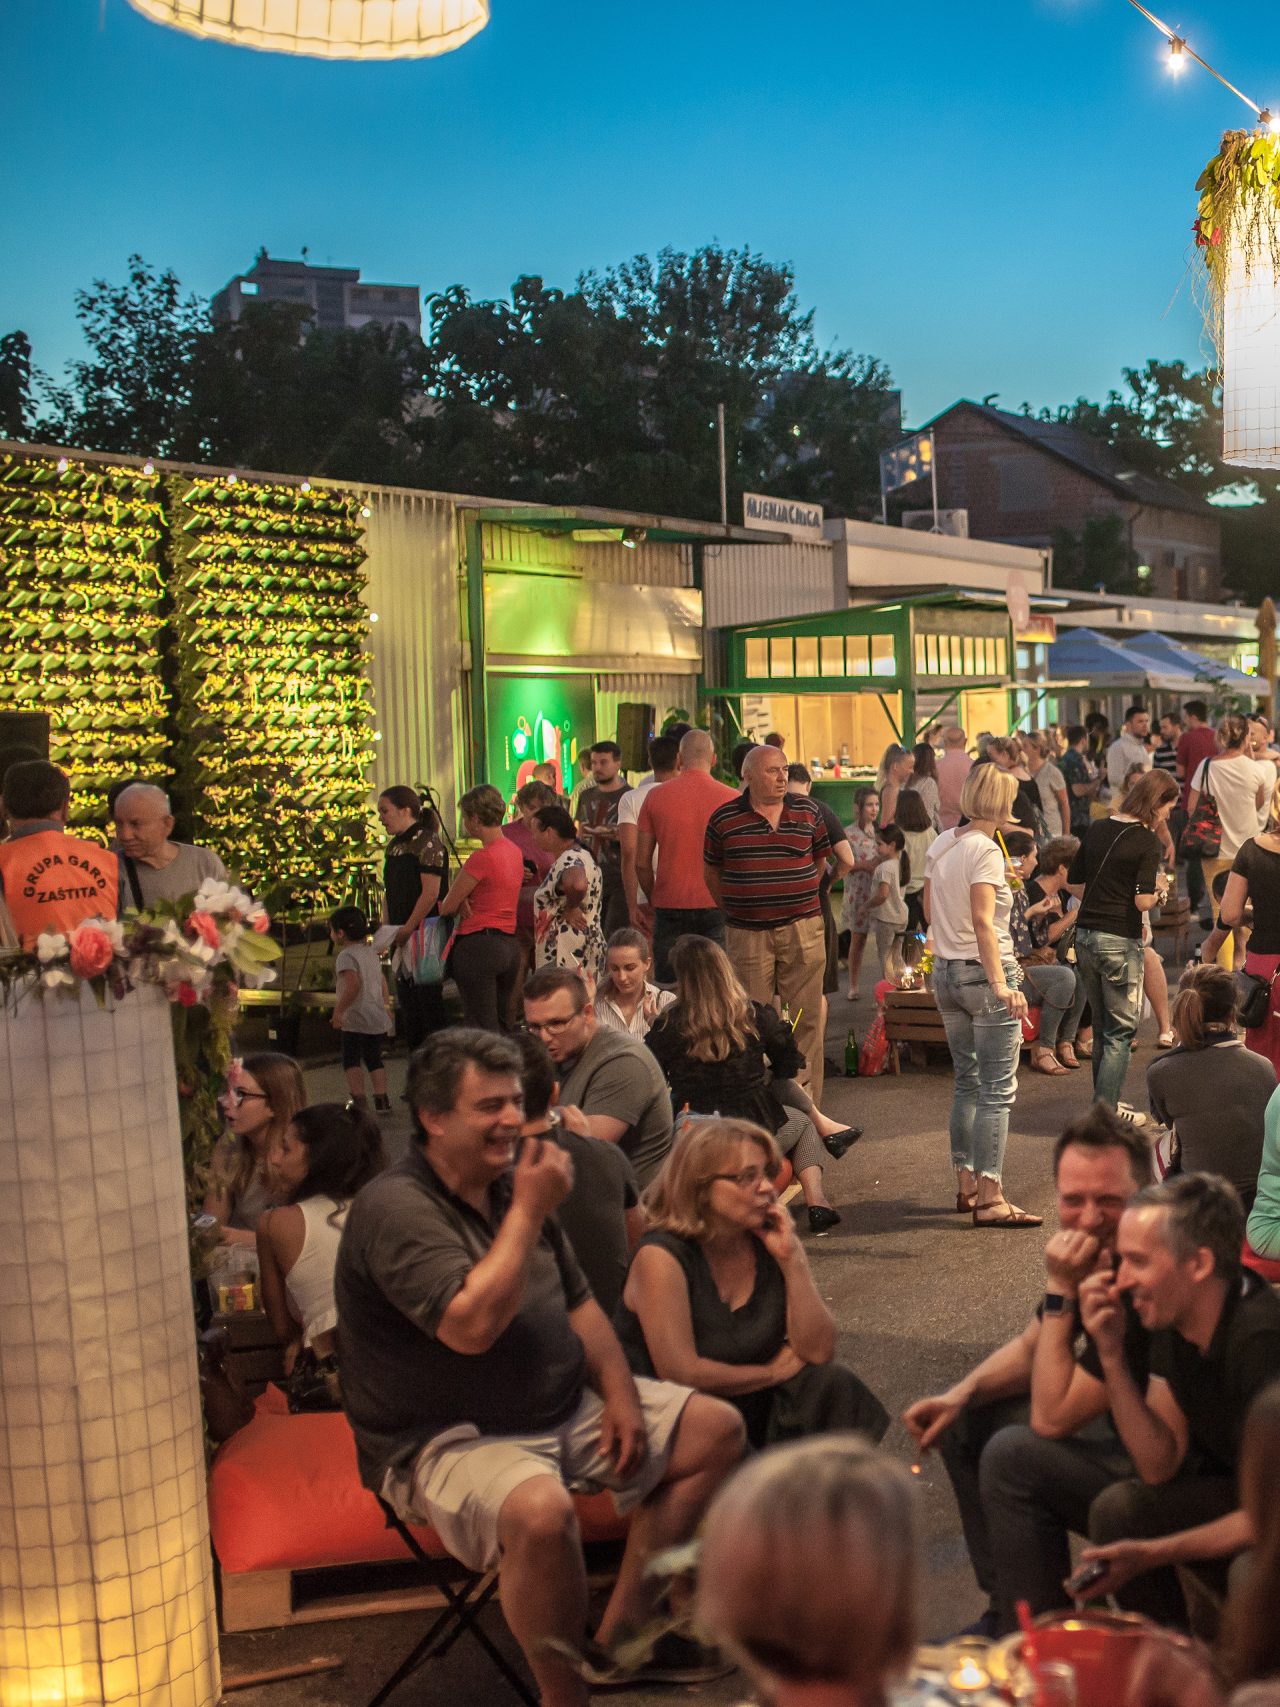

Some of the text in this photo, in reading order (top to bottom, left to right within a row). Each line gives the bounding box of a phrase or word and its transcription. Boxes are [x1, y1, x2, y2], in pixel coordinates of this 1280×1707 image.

[23, 855, 107, 898] GRUPA GARD
[37, 886, 97, 904] ZAŠTITA
